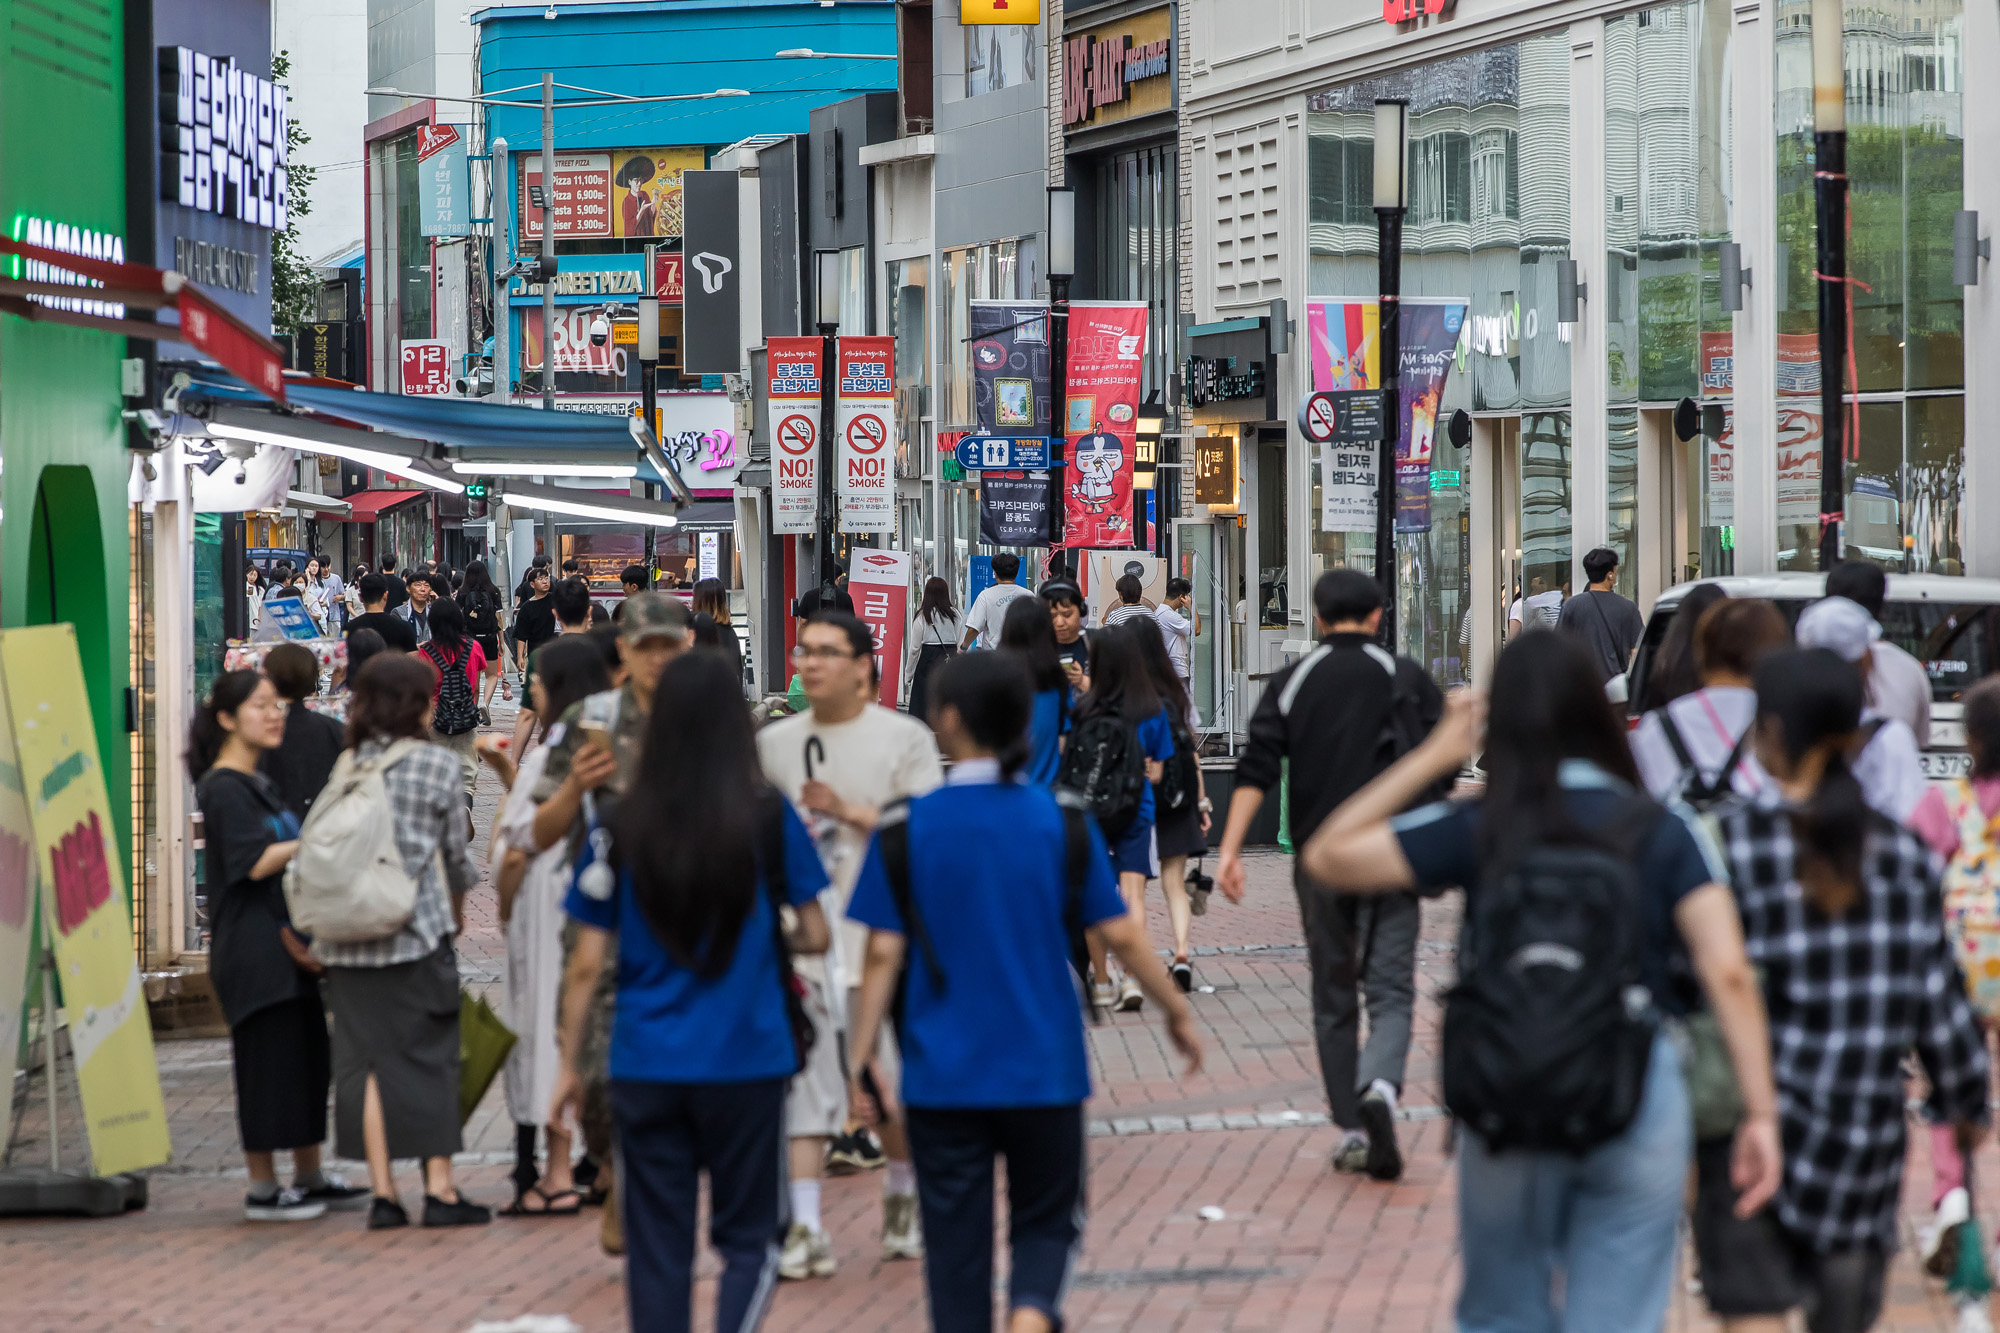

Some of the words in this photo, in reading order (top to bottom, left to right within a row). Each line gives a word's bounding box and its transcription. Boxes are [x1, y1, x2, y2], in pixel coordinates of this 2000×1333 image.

[1062, 35, 1123, 125] ABC-MART
[554, 273, 599, 294] STREET
[600, 271, 643, 293] PIZZA
[777, 363, 814, 378] 동성로
[848, 362, 885, 377] 동성로
[772, 378, 820, 393] 금연거리
[842, 377, 891, 393] 금연거리
[779, 459, 814, 478] NO!
[848, 458, 885, 477] NO!
[780, 479, 813, 489] SMOKE
[848, 478, 885, 488] SMOKE
